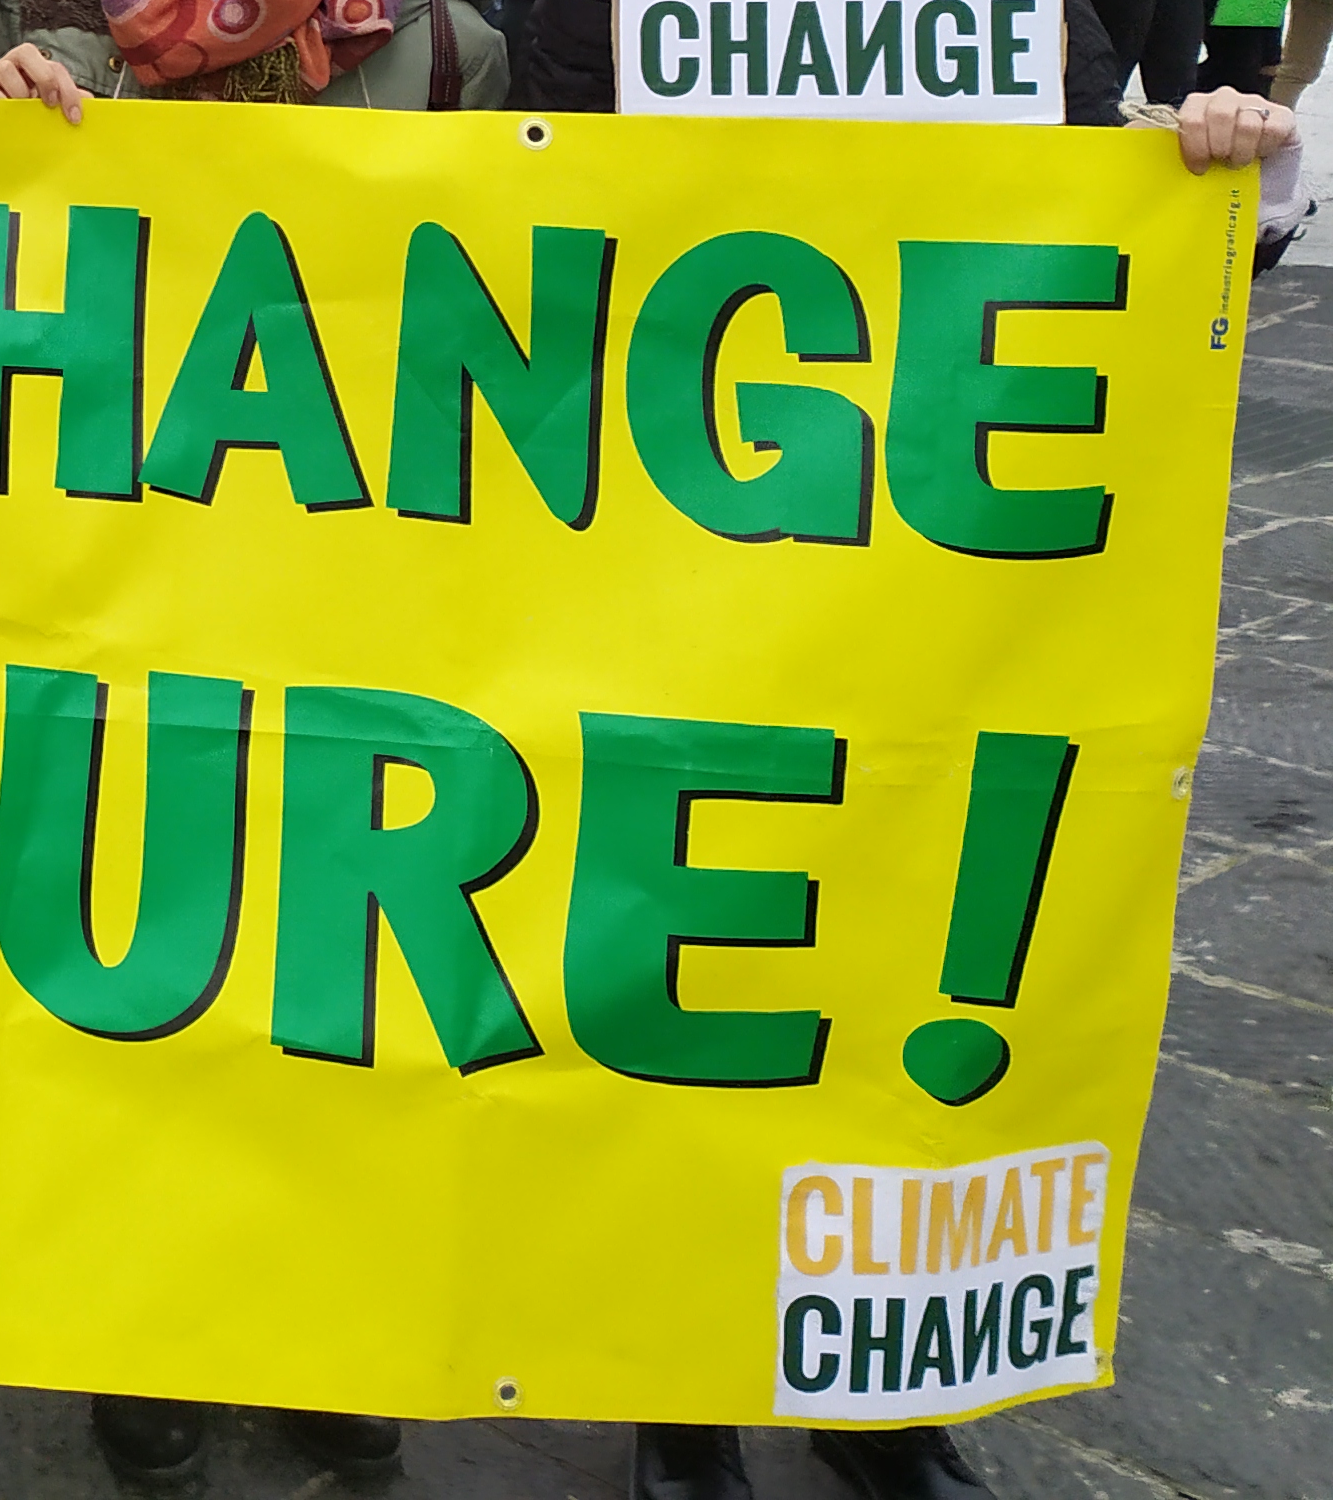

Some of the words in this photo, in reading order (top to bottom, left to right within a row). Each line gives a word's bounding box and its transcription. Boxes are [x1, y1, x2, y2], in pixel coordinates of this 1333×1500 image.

[1209, 316, 1229, 350] FG
[785, 1153, 1106, 1277] CLIMATE
[781, 1264, 1096, 1394] CHANGE
